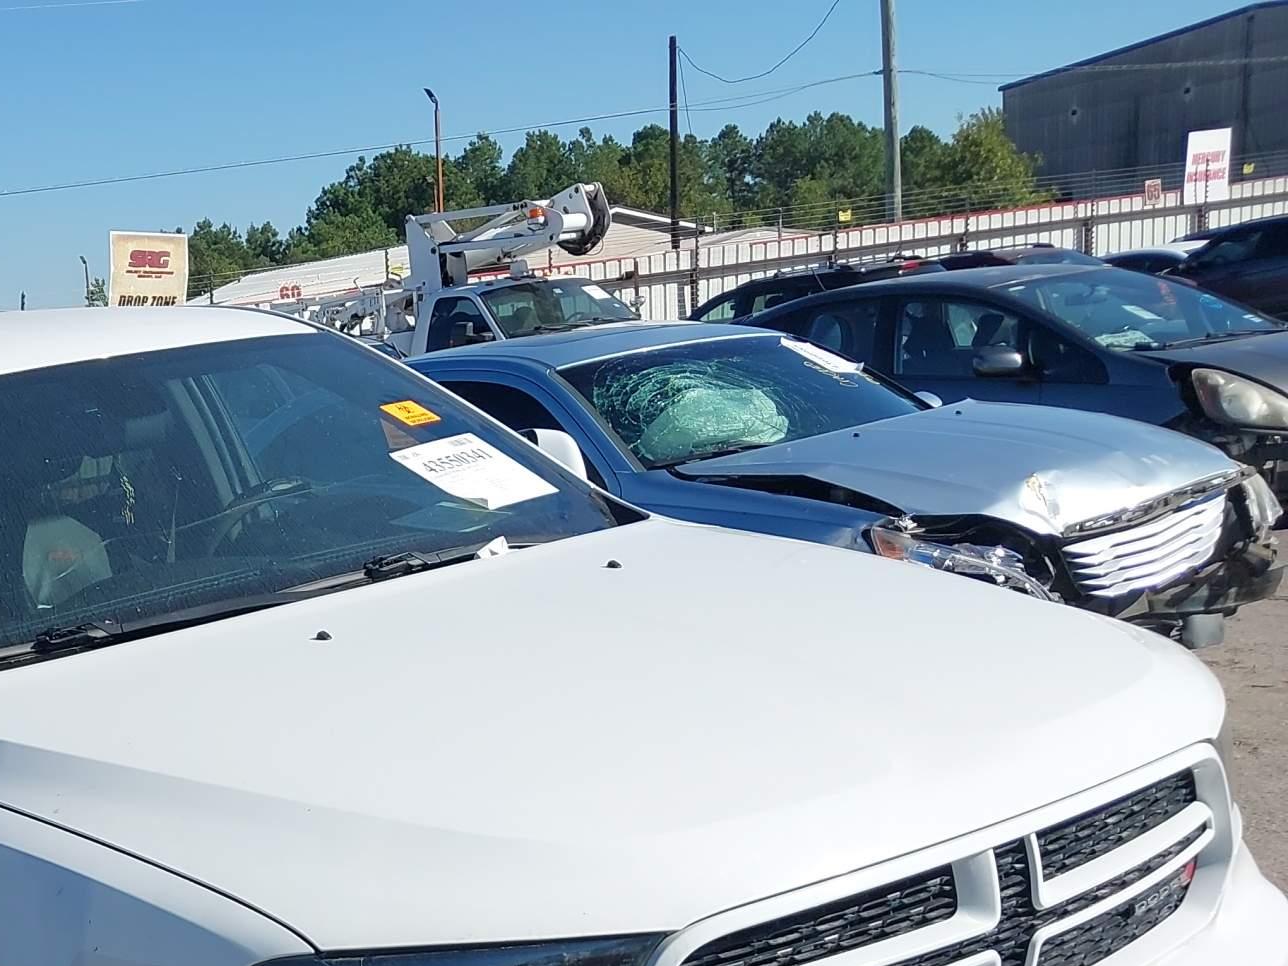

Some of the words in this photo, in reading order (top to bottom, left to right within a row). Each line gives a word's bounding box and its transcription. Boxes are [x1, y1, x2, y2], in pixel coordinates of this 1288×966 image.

[128, 250, 171, 268] SRG
[118, 295, 149, 306] DROP
[150, 296, 178, 306] ZONE
[422, 448, 493, 474] 43550341
